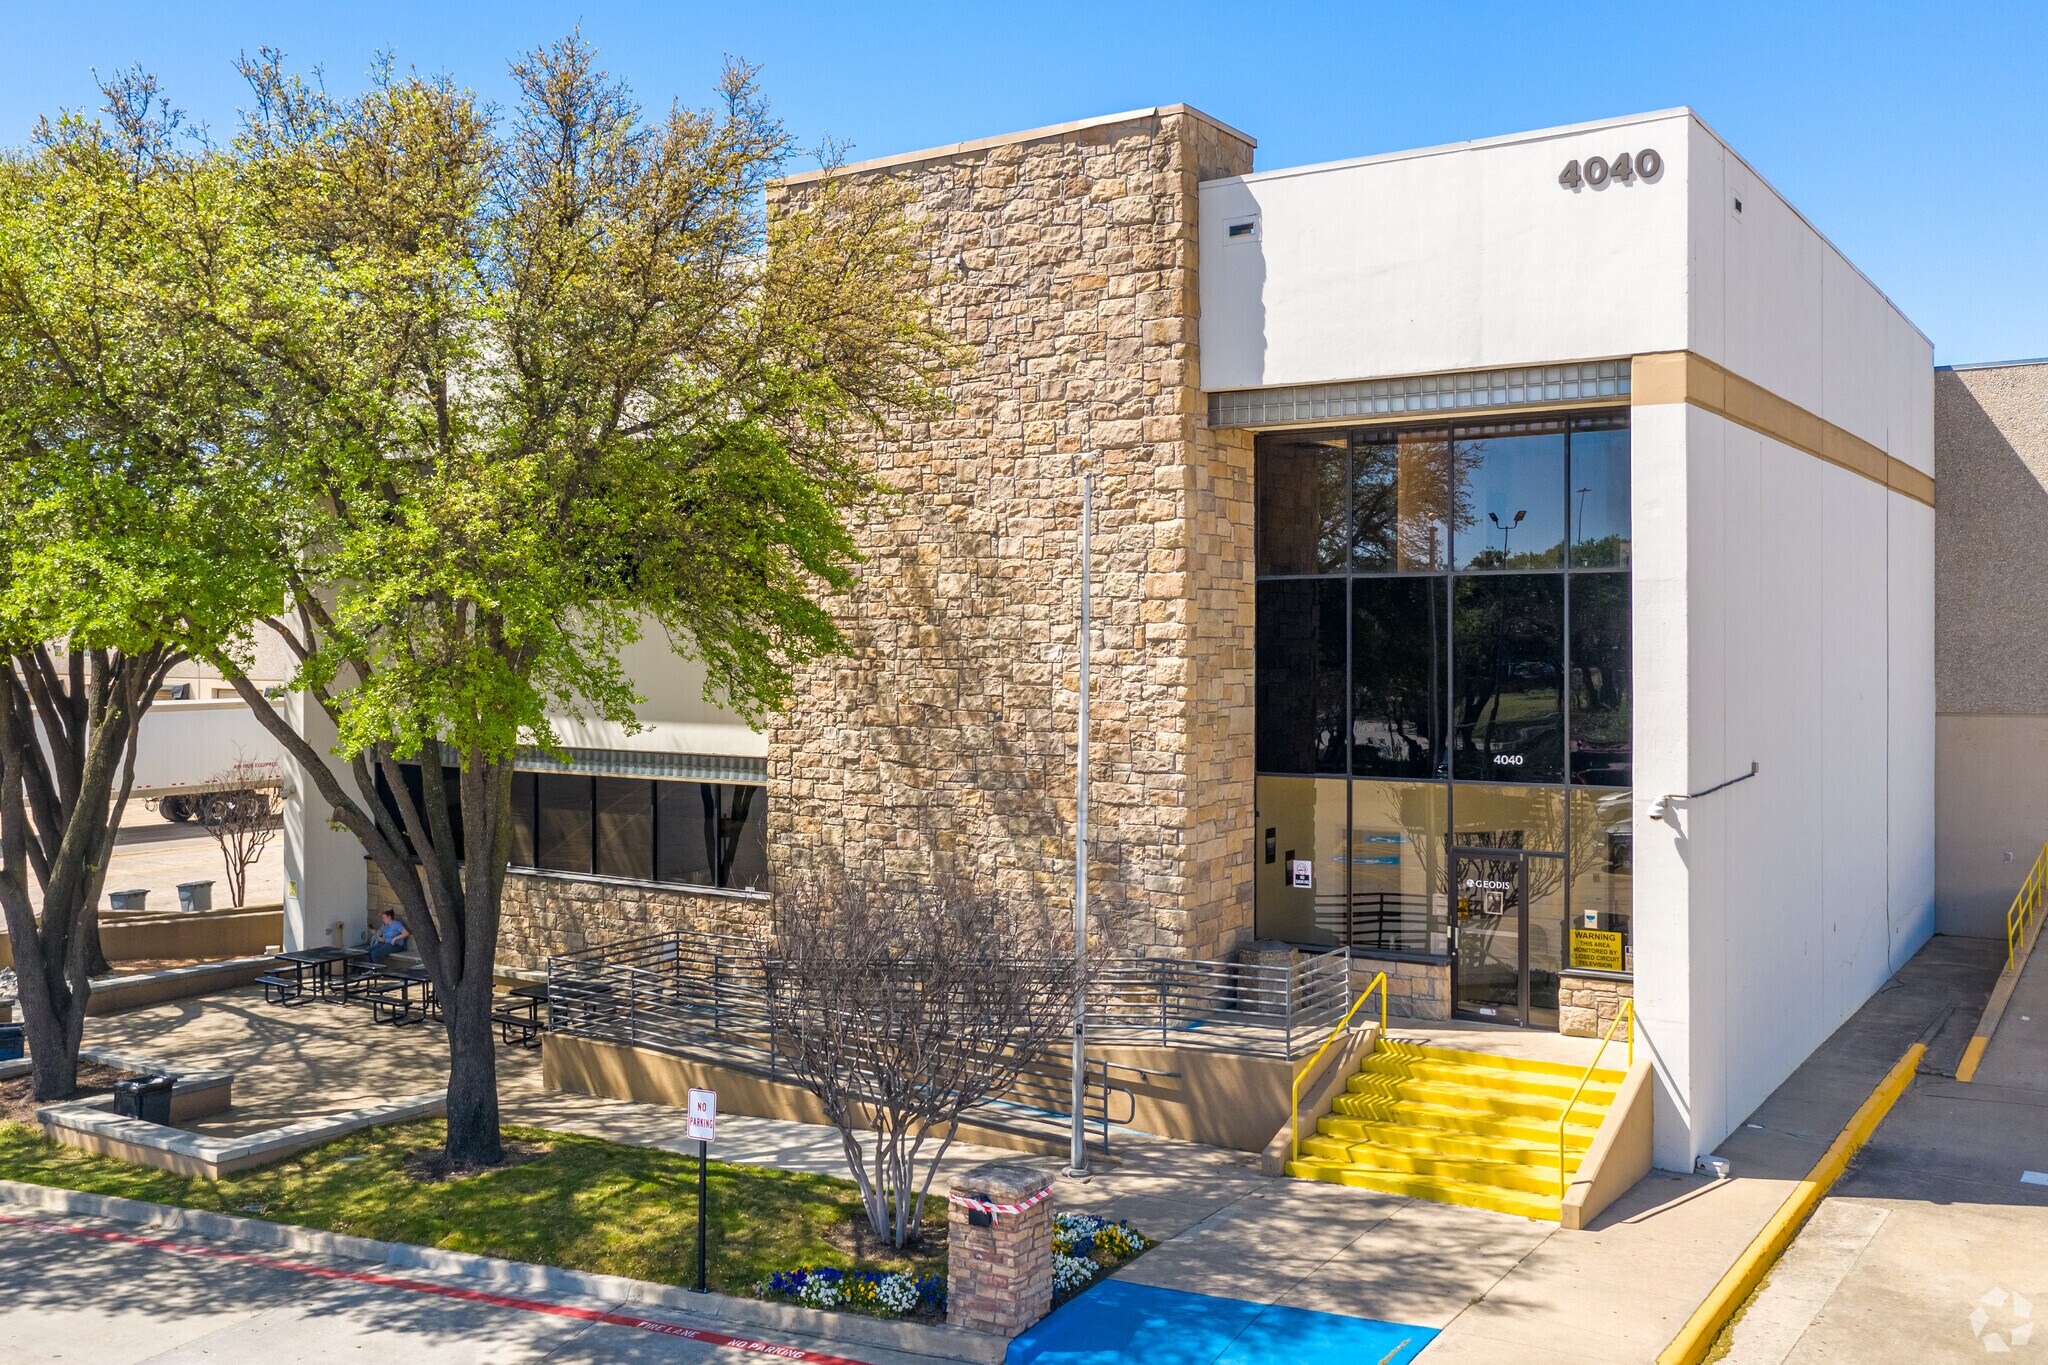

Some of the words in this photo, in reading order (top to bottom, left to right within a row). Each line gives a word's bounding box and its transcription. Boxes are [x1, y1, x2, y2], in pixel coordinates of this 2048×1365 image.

[1558, 148, 1661, 188] 4040
[1493, 754, 1524, 765] 4040
[1475, 879, 1510, 890] GEODIS
[1575, 931, 1615, 941] WARNING
[1579, 960, 1612, 968] TELEVISION
[697, 1102, 706, 1112] NO
[690, 1117, 713, 1129] PARKING
[636, 1321, 667, 1332] FIRE
[663, 1326, 701, 1339] LANE
[726, 1338, 749, 1348] NO
[747, 1341, 806, 1359] PARKING
